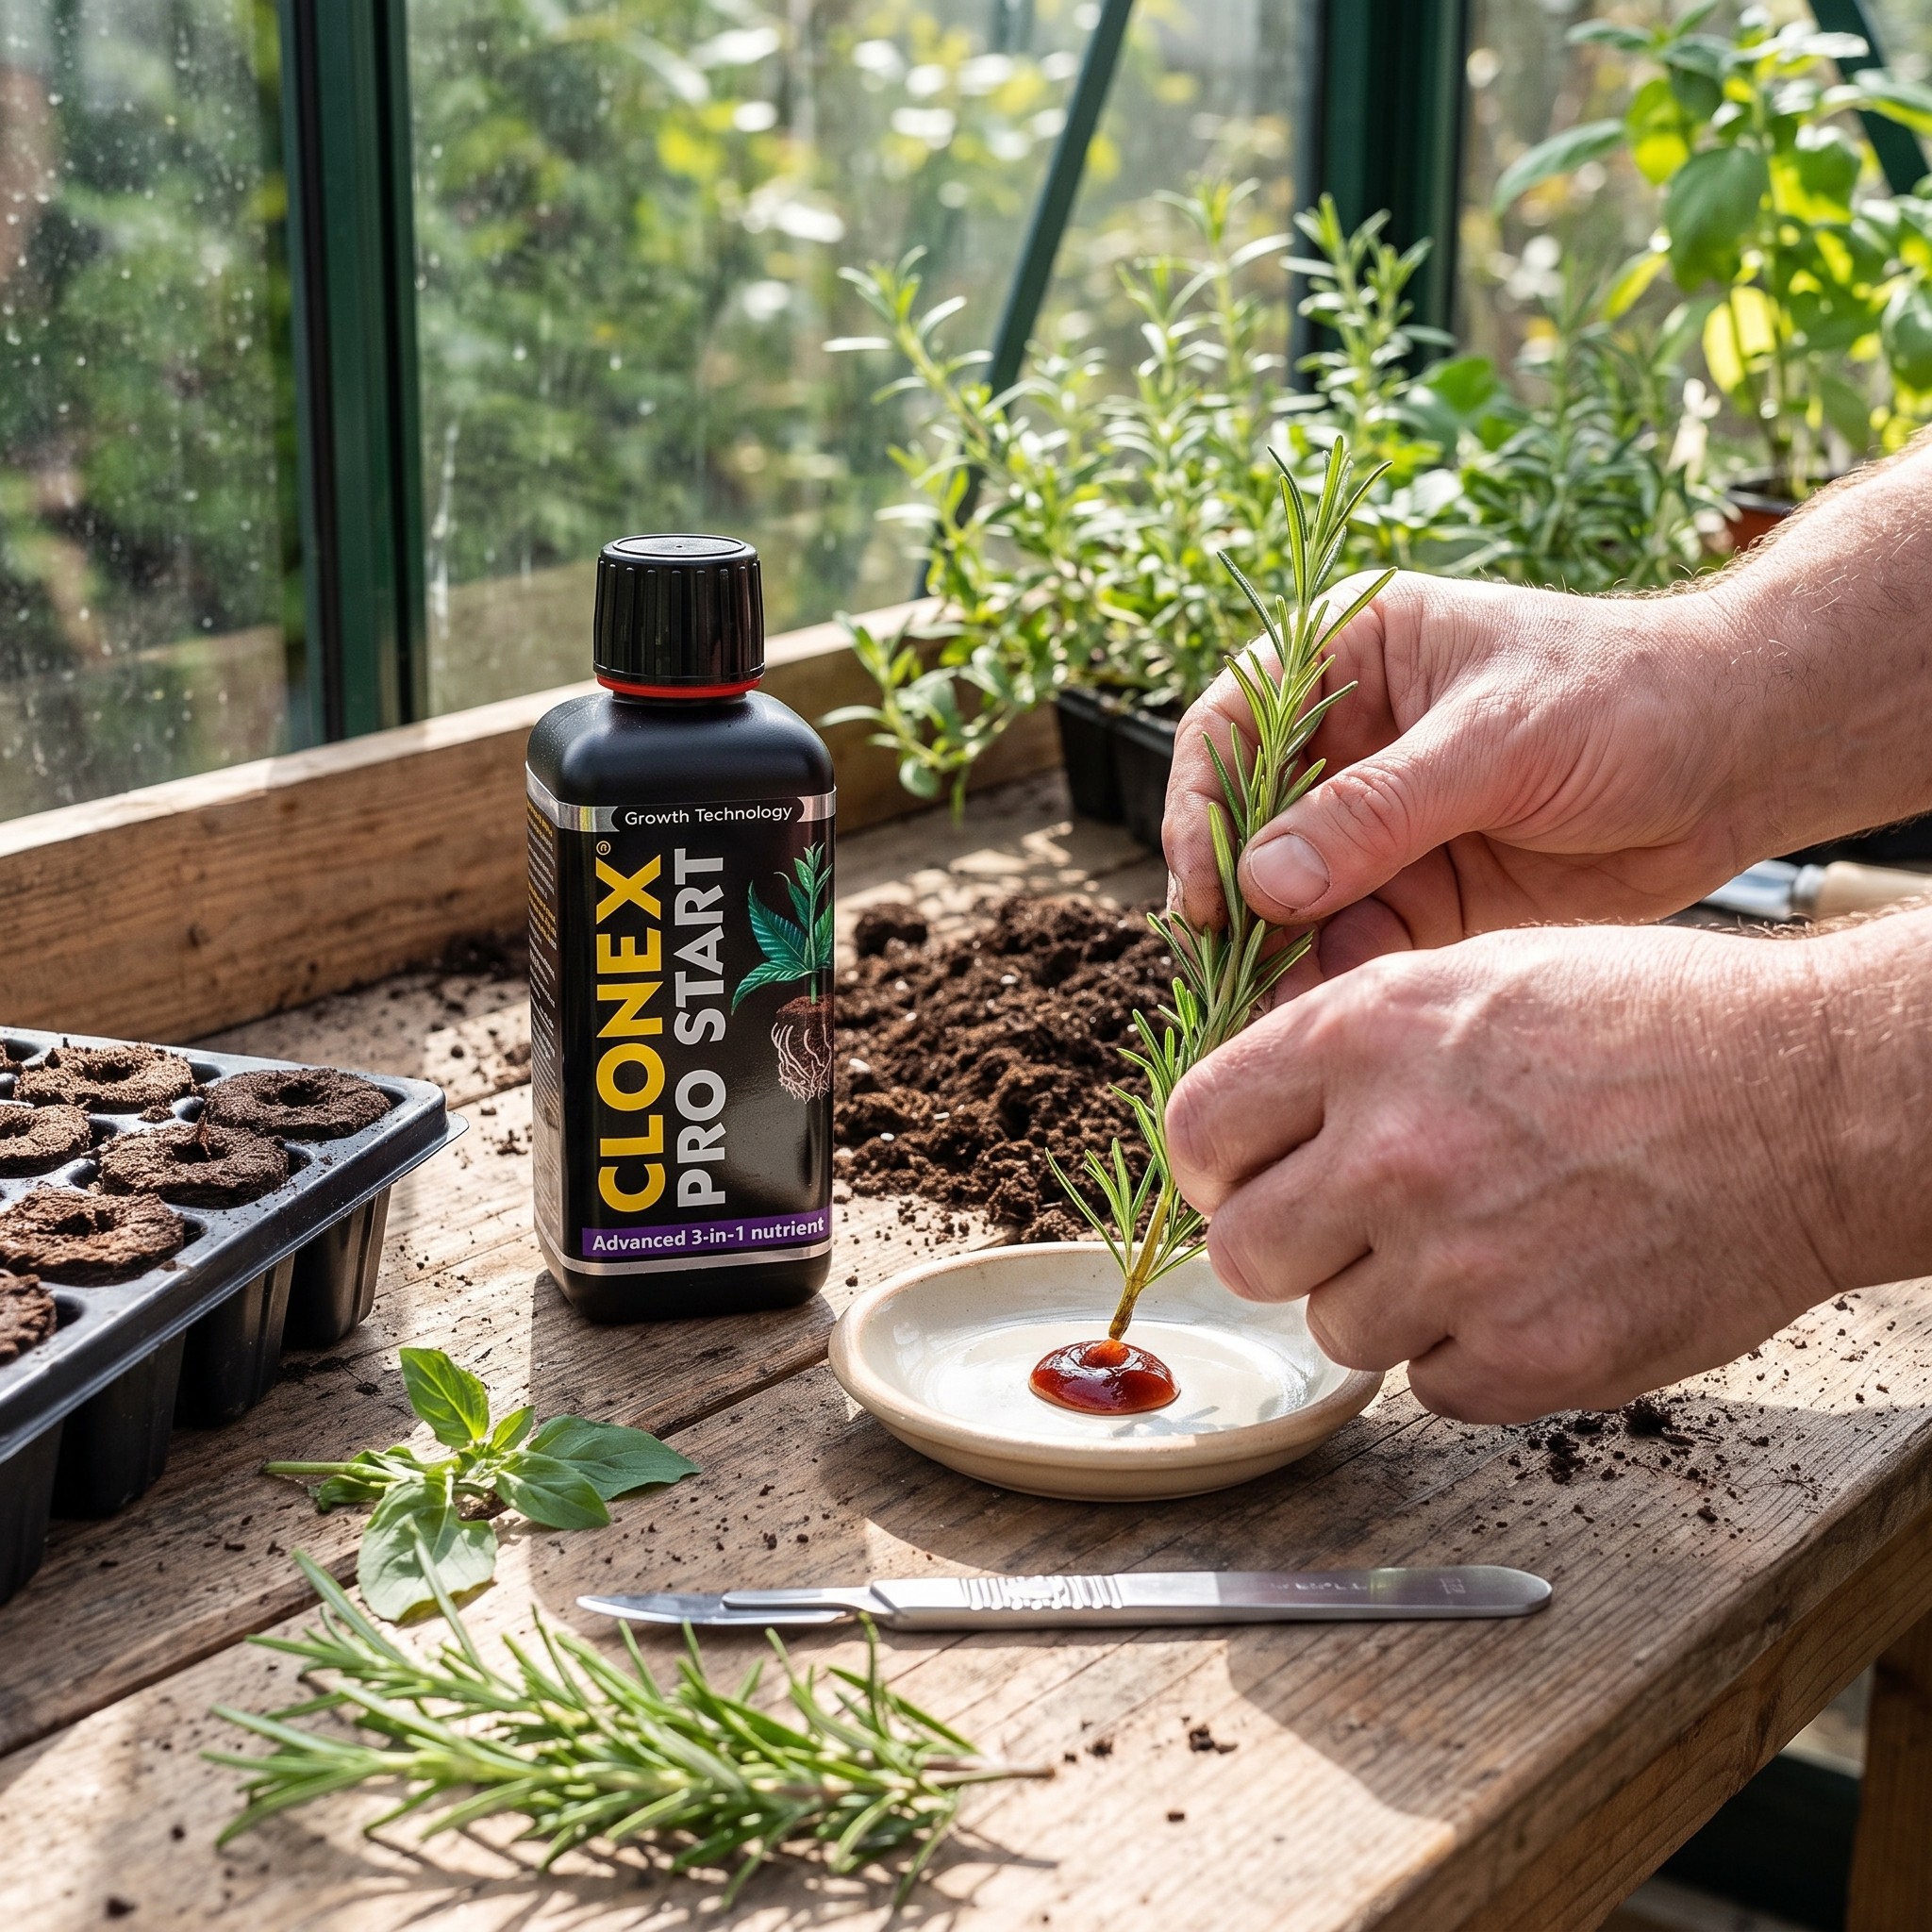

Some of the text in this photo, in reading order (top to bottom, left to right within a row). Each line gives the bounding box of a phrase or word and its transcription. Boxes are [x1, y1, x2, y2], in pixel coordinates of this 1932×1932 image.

[625, 805, 793, 825] Growth Technology
[674, 847, 727, 1208] PRO START
[591, 1216, 824, 1251] Advanced 3-in-1 nutrient
